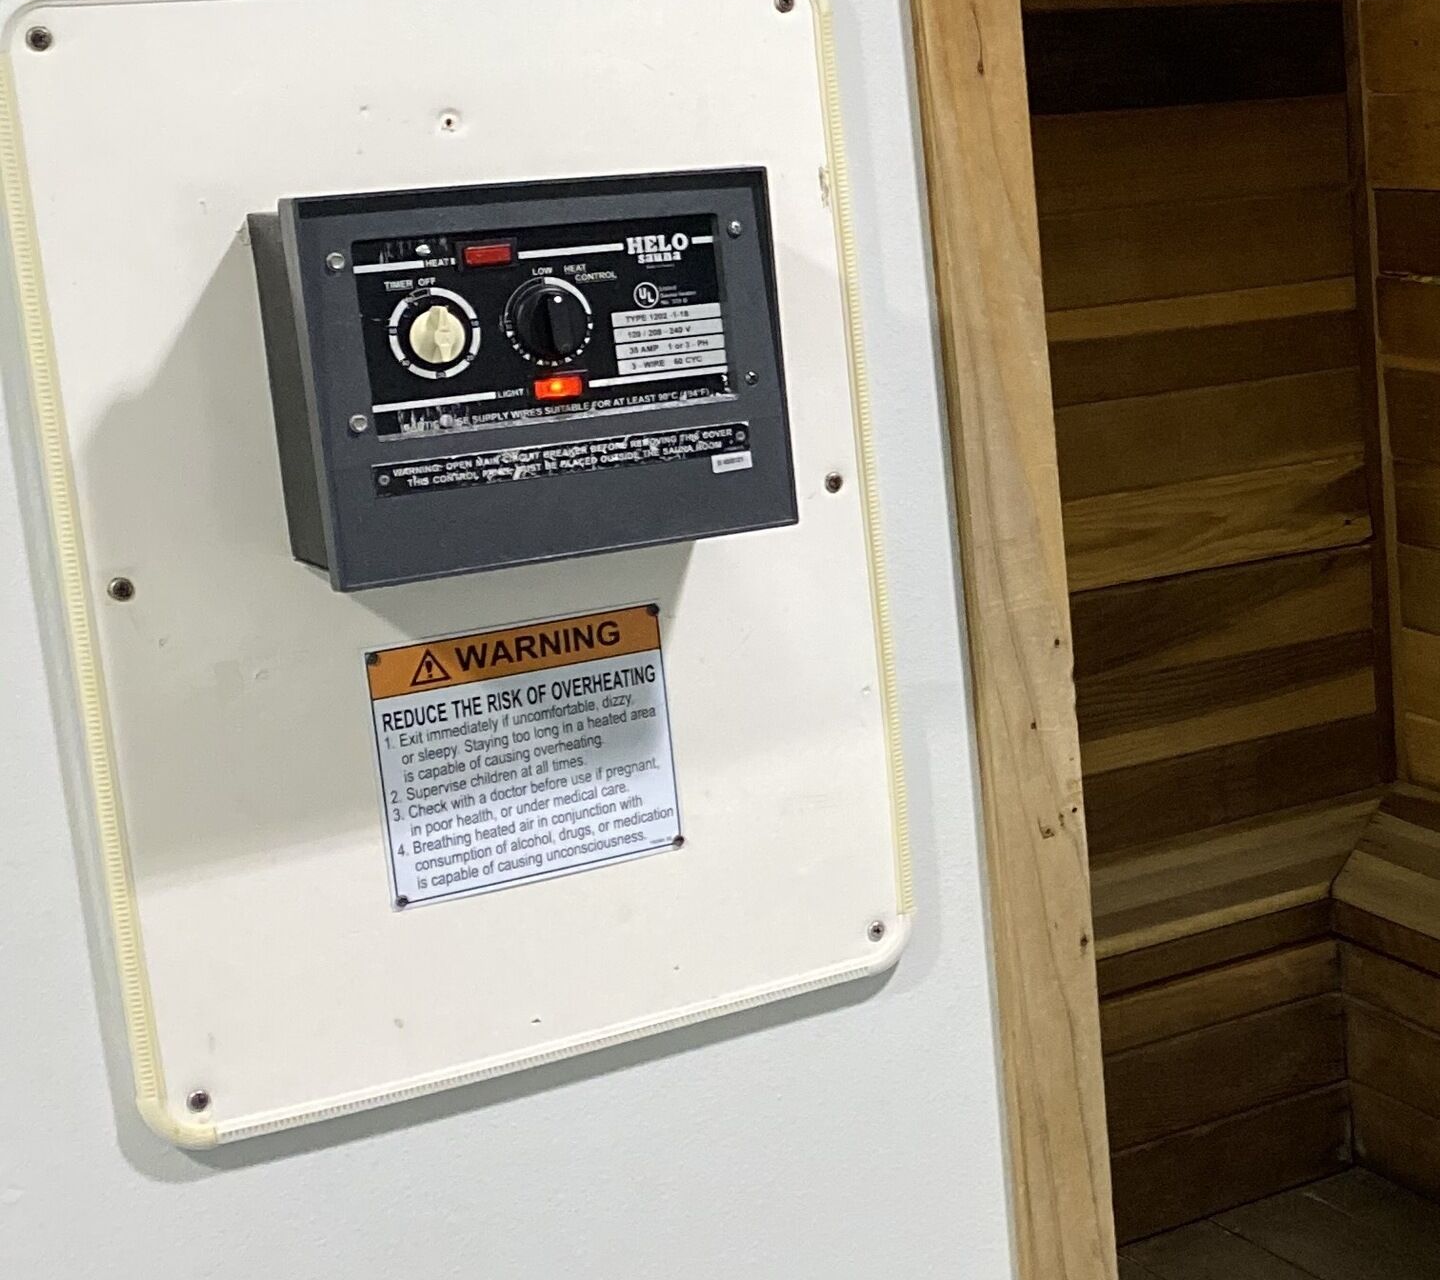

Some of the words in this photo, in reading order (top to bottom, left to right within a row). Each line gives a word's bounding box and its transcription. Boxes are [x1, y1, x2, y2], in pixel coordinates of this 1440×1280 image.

[425, 257, 449, 267] HEAT
[626, 233, 689, 254] HELO
[638, 252, 681, 264] sauna
[384, 280, 413, 290] TIMER
[418, 277, 436, 286] OFF
[532, 267, 552, 275] LOW
[563, 264, 586, 273] HEAT
[575, 271, 617, 281] CONTROL
[625, 314, 646, 322] TYPE
[643, 360, 665, 368] WIRE
[472, 412, 508, 424] SUPPLY
[511, 409, 542, 420] WIRES
[545, 401, 590, 415] SUITABLE
[593, 399, 611, 409] FOR
[614, 397, 624, 406] AT
[627, 394, 655, 404] LEAST
[497, 388, 524, 398] LIGHT
[407, 476, 429, 488] THIS
[433, 472, 479, 484] CONTROL
[560, 455, 597, 468] PLACED
[600, 450, 639, 463] OUTSIDE
[643, 446, 660, 457] THE
[663, 442, 694, 455] SAUNA
[446, 460, 473, 470] OPEN
[543, 446, 588, 460] BREAKER
[590, 441, 627, 453] BEFORE
[630, 435, 677, 448] REMOVING
[680, 431, 699, 442] THIS
[702, 428, 732, 439] COVER
[455, 621, 620, 672] WARNING
[382, 702, 448, 732] REDUCE
[451, 696, 483, 719] THE
[487, 688, 523, 713] RISK
[527, 684, 546, 705] OF
[551, 664, 656, 701] OVERHEATING
[399, 732, 424, 748] Exit
[427, 717, 499, 741] immediately
[502, 714, 509, 727] if
[512, 700, 600, 725] uncomfortable,
[402, 754, 414, 765] or
[464, 733, 509, 752] Staying
[512, 730, 530, 743] too
[534, 725, 559, 741] long
[563, 721, 572, 733] in
[577, 721, 584, 731] a
[587, 711, 627, 729] heated
[631, 707, 656, 720] area
[390, 790, 402, 804] 2.
[406, 779, 467, 801] Supervise
[470, 770, 520, 788] children
[521, 764, 532, 778] at
[536, 761, 548, 775] all
[404, 770, 414, 783] is
[418, 762, 466, 782] capable
[469, 757, 481, 770] of
[485, 749, 530, 767] causing
[393, 808, 404, 822] 3.
[408, 799, 448, 819] Check
[451, 794, 475, 810] with
[480, 794, 487, 804] a
[490, 785, 527, 802] doctor
[530, 777, 568, 794] before
[571, 771, 592, 786] use
[595, 767, 603, 780] if
[605, 757, 660, 781] pregnant,
[397, 843, 409, 856] 4.
[412, 832, 472, 855] Breathing
[475, 821, 516, 840] heated
[519, 818, 534, 832] air
[537, 814, 548, 828] in
[551, 801, 617, 825] conjunction
[620, 795, 643, 811] with
[410, 824, 422, 837] in
[425, 818, 453, 837] poor
[456, 808, 497, 827] health,
[500, 806, 512, 818] or
[516, 799, 550, 815] under
[553, 786, 598, 807] medical
[601, 783, 630, 798] care.
[415, 846, 492, 872] consumption
[495, 840, 507, 855] of
[511, 831, 556, 852] alcohol,
[558, 824, 595, 841] drugs,
[598, 820, 610, 832] or
[613, 807, 674, 827] medication
[417, 876, 428, 890] is
[431, 867, 479, 888] capable
[482, 860, 494, 876] of
[498, 852, 543, 873] causing
[546, 830, 647, 862] unconsciousness.
